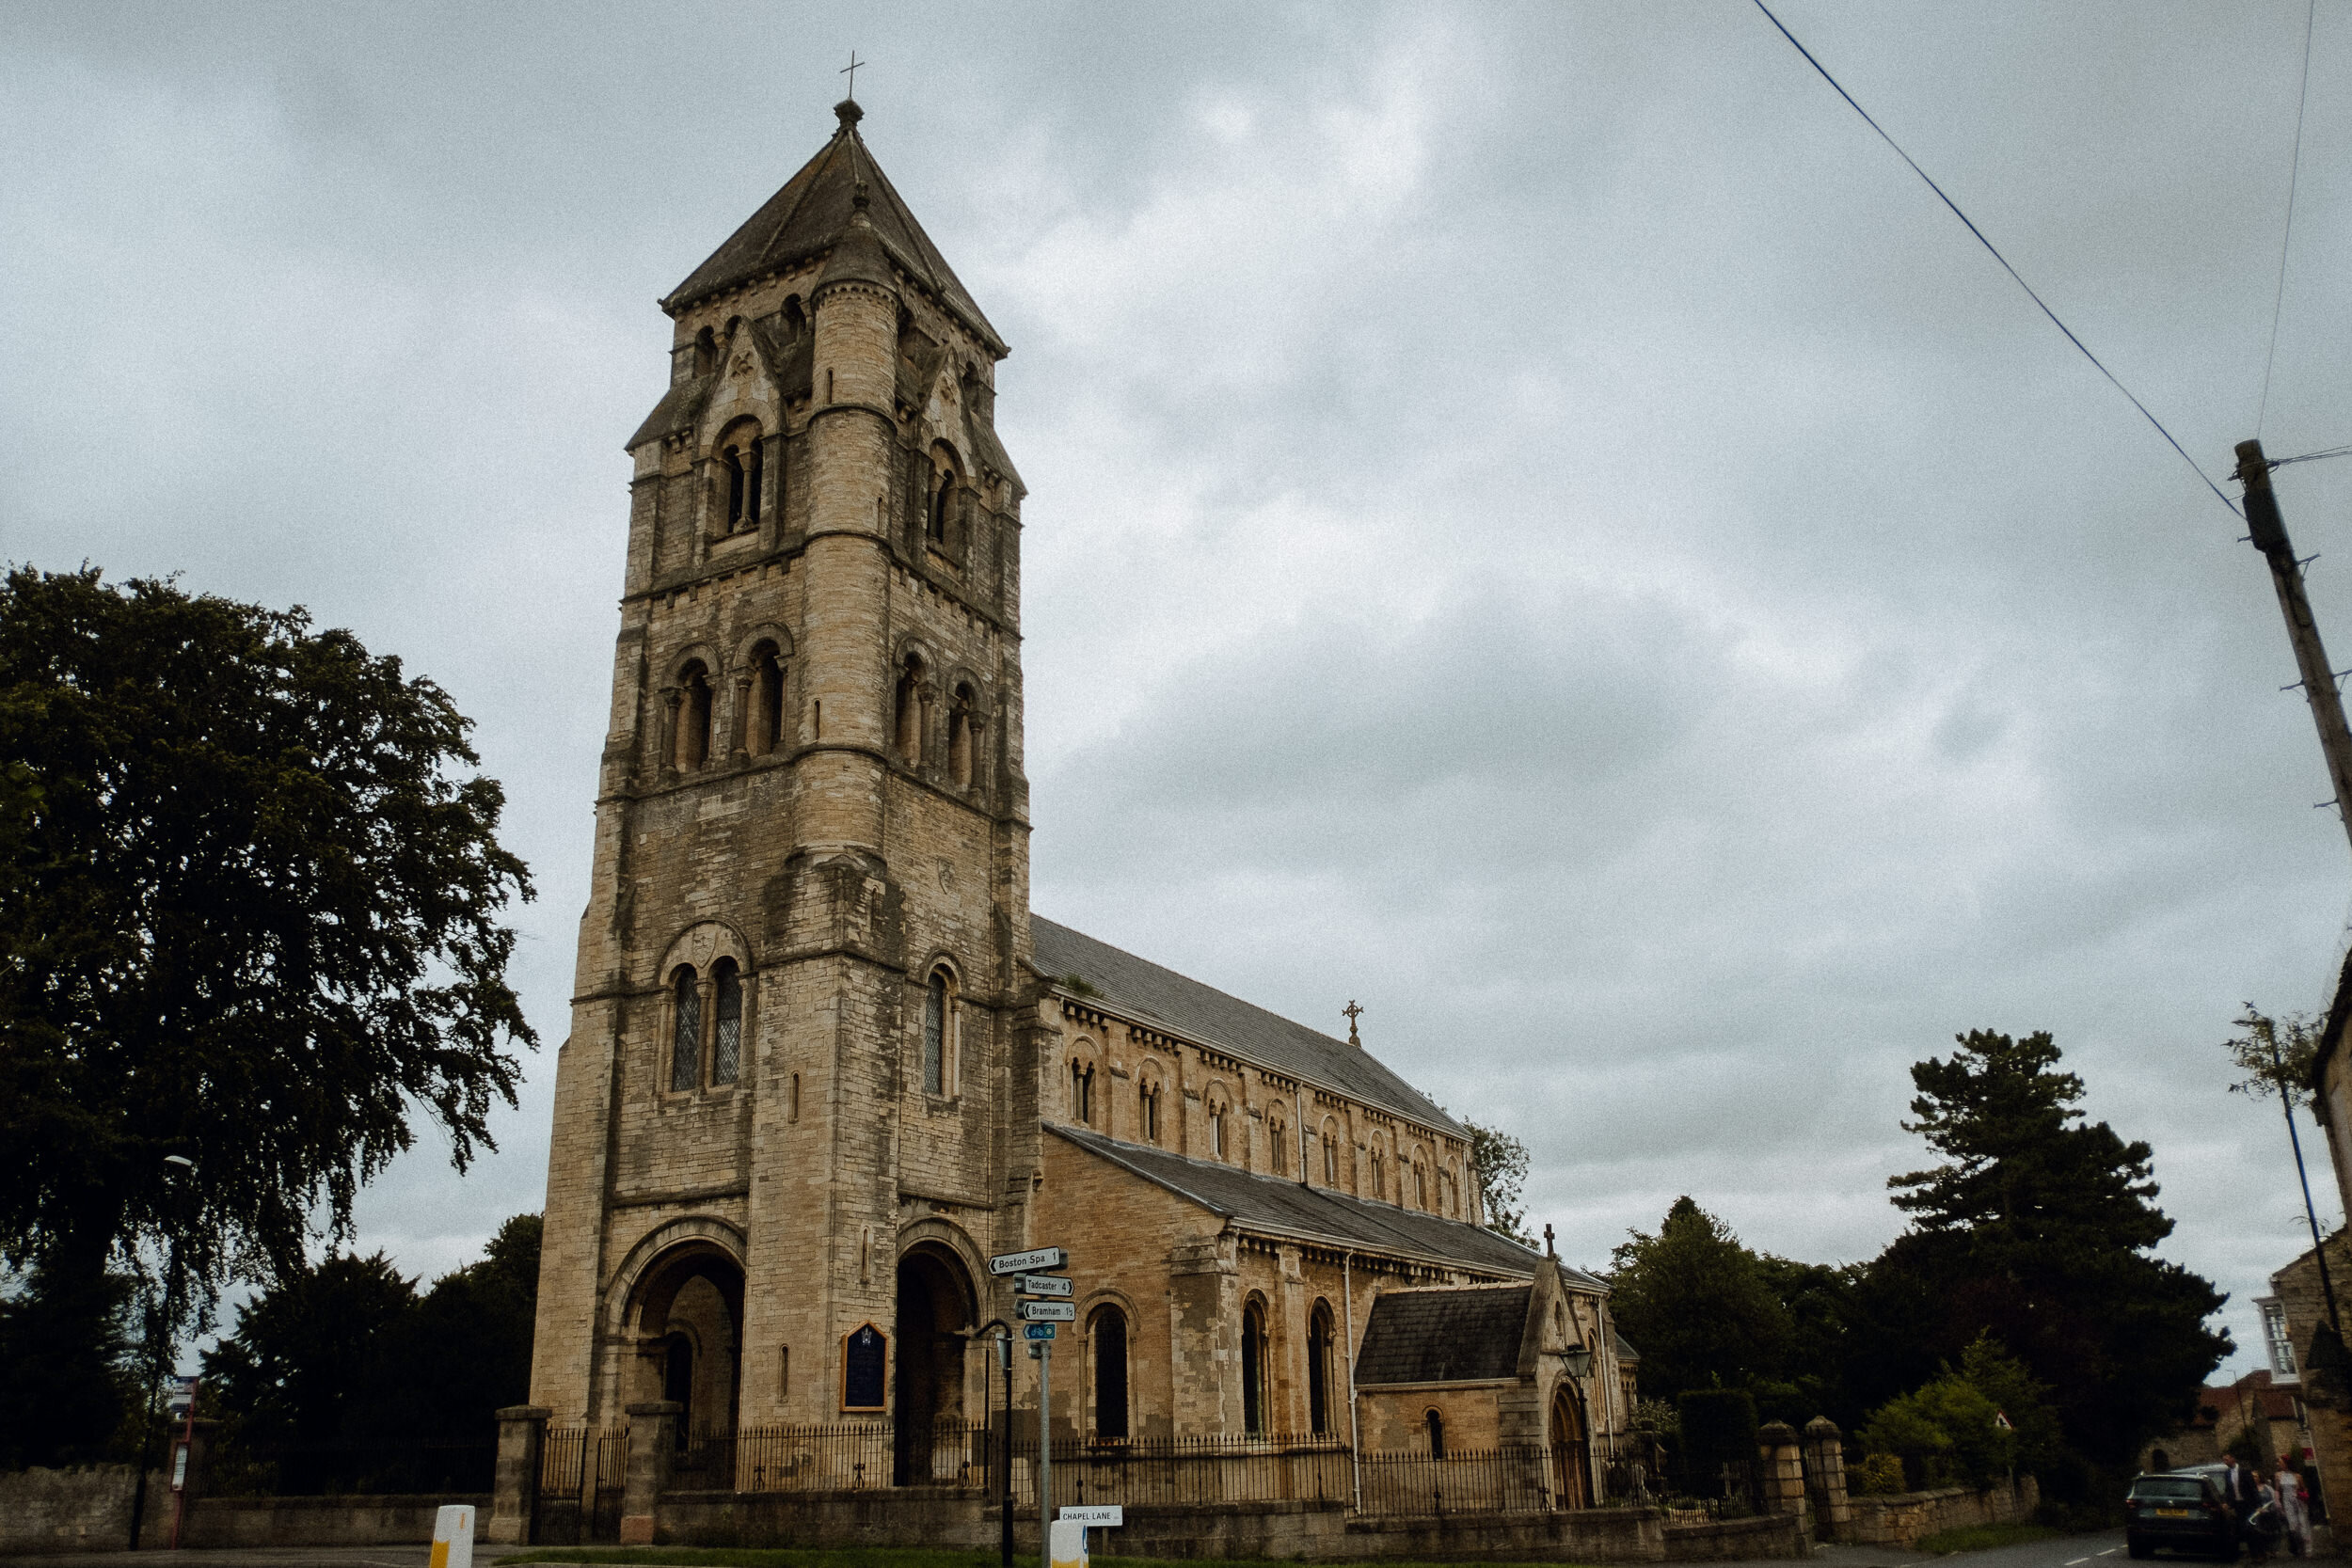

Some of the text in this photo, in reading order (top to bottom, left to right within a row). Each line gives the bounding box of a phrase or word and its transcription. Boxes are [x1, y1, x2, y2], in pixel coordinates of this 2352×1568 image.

[999, 1252, 1057, 1269] Boston Spa 1
[1027, 1280, 1057, 1291] Tadcaster
[1032, 1307, 1060, 1316] Bramham
[1092, 1512, 1111, 1520] LANE
